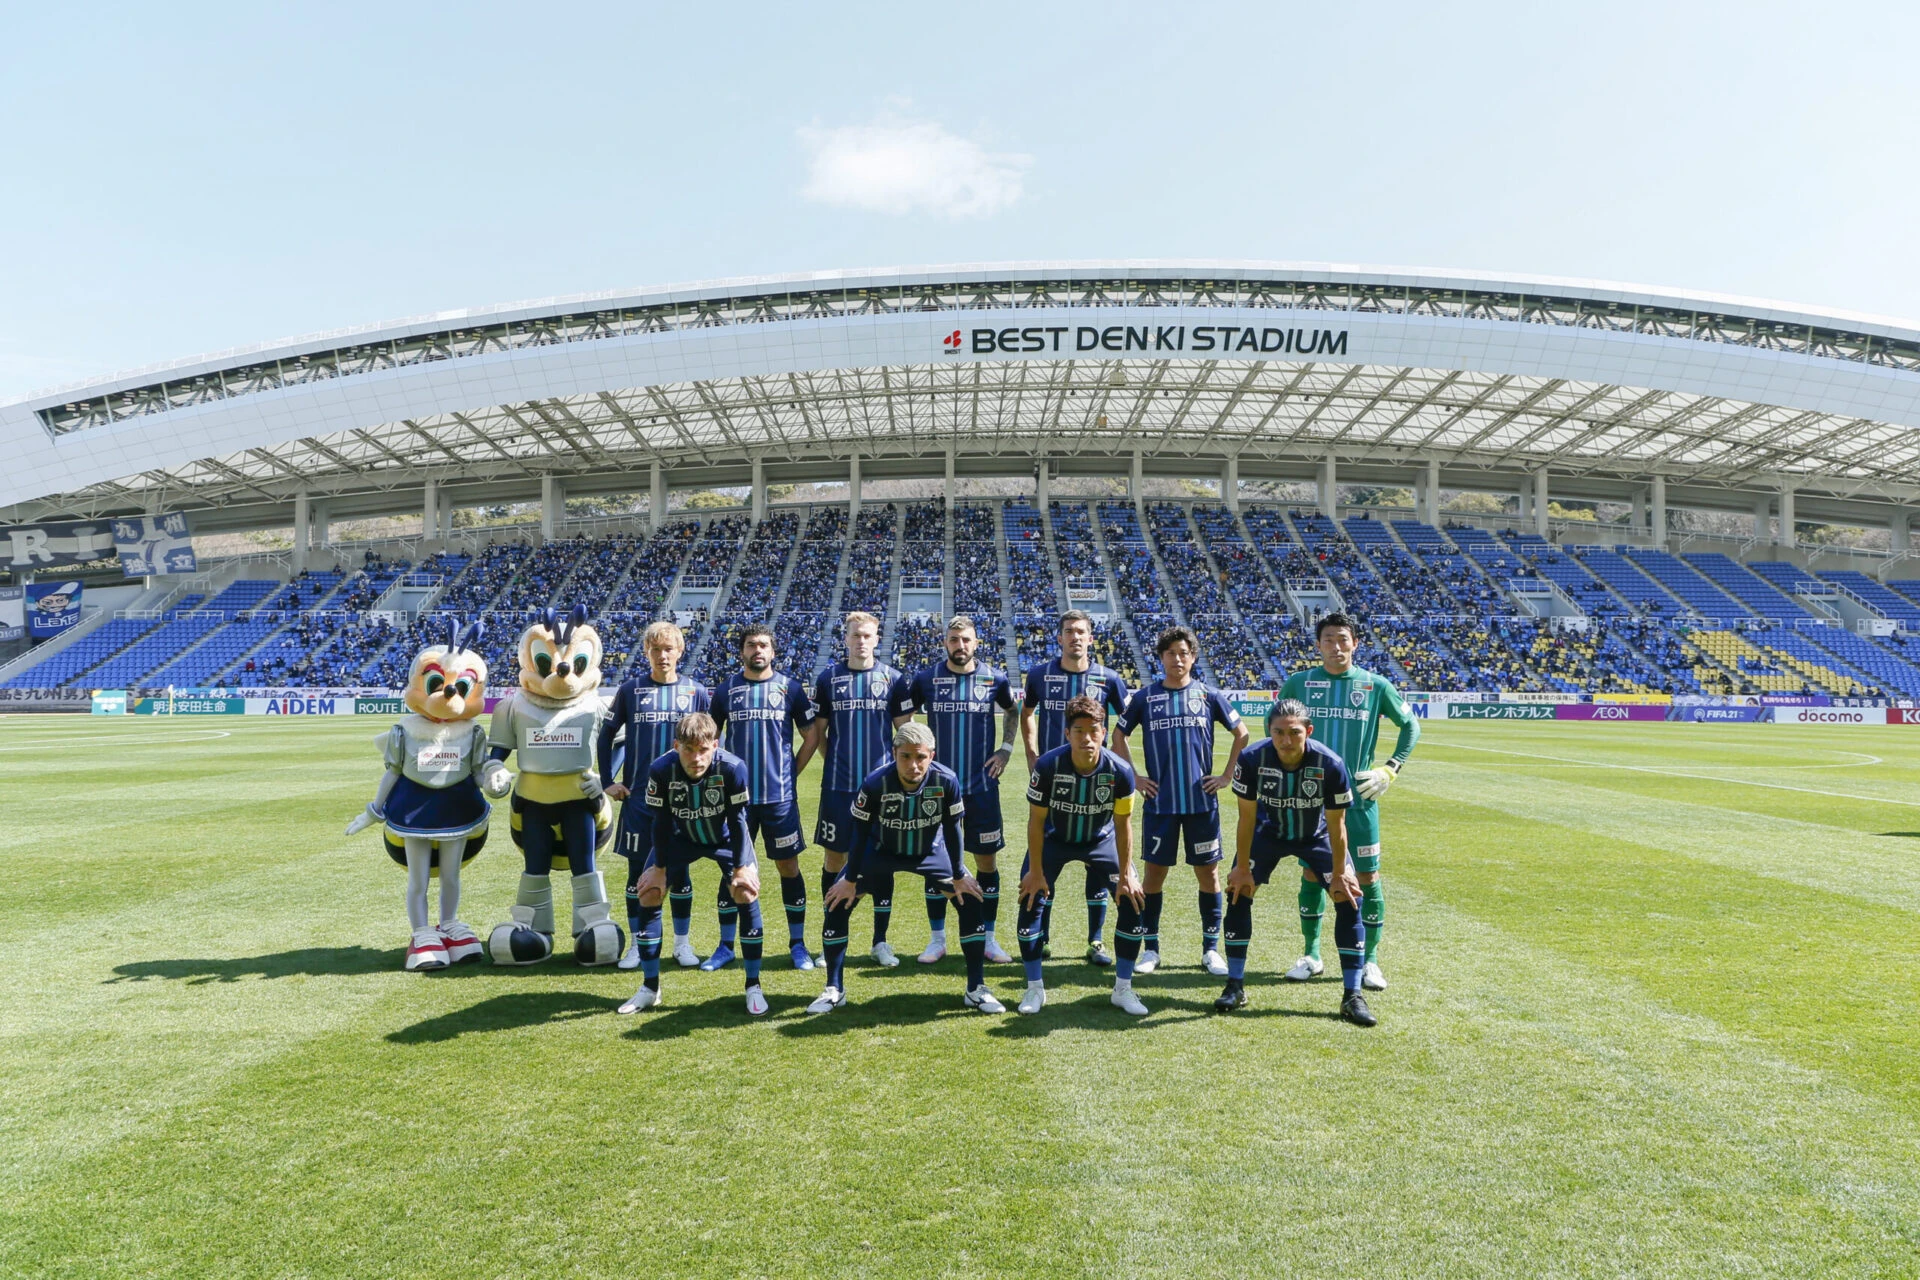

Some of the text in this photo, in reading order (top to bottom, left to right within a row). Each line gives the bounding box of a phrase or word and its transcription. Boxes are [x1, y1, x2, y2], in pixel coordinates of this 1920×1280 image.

[972, 326, 1348, 355] BEST DENKI STADIUM
[153, 700, 227, 713] 明治安田生命
[358, 703, 398, 713] ROUTE
[1798, 708, 1863, 722] docomo
[533, 732, 575, 742] Bewith
[821, 820, 836, 842] 33
[626, 831, 639, 852] 11
[1152, 836, 1162, 855] 7
